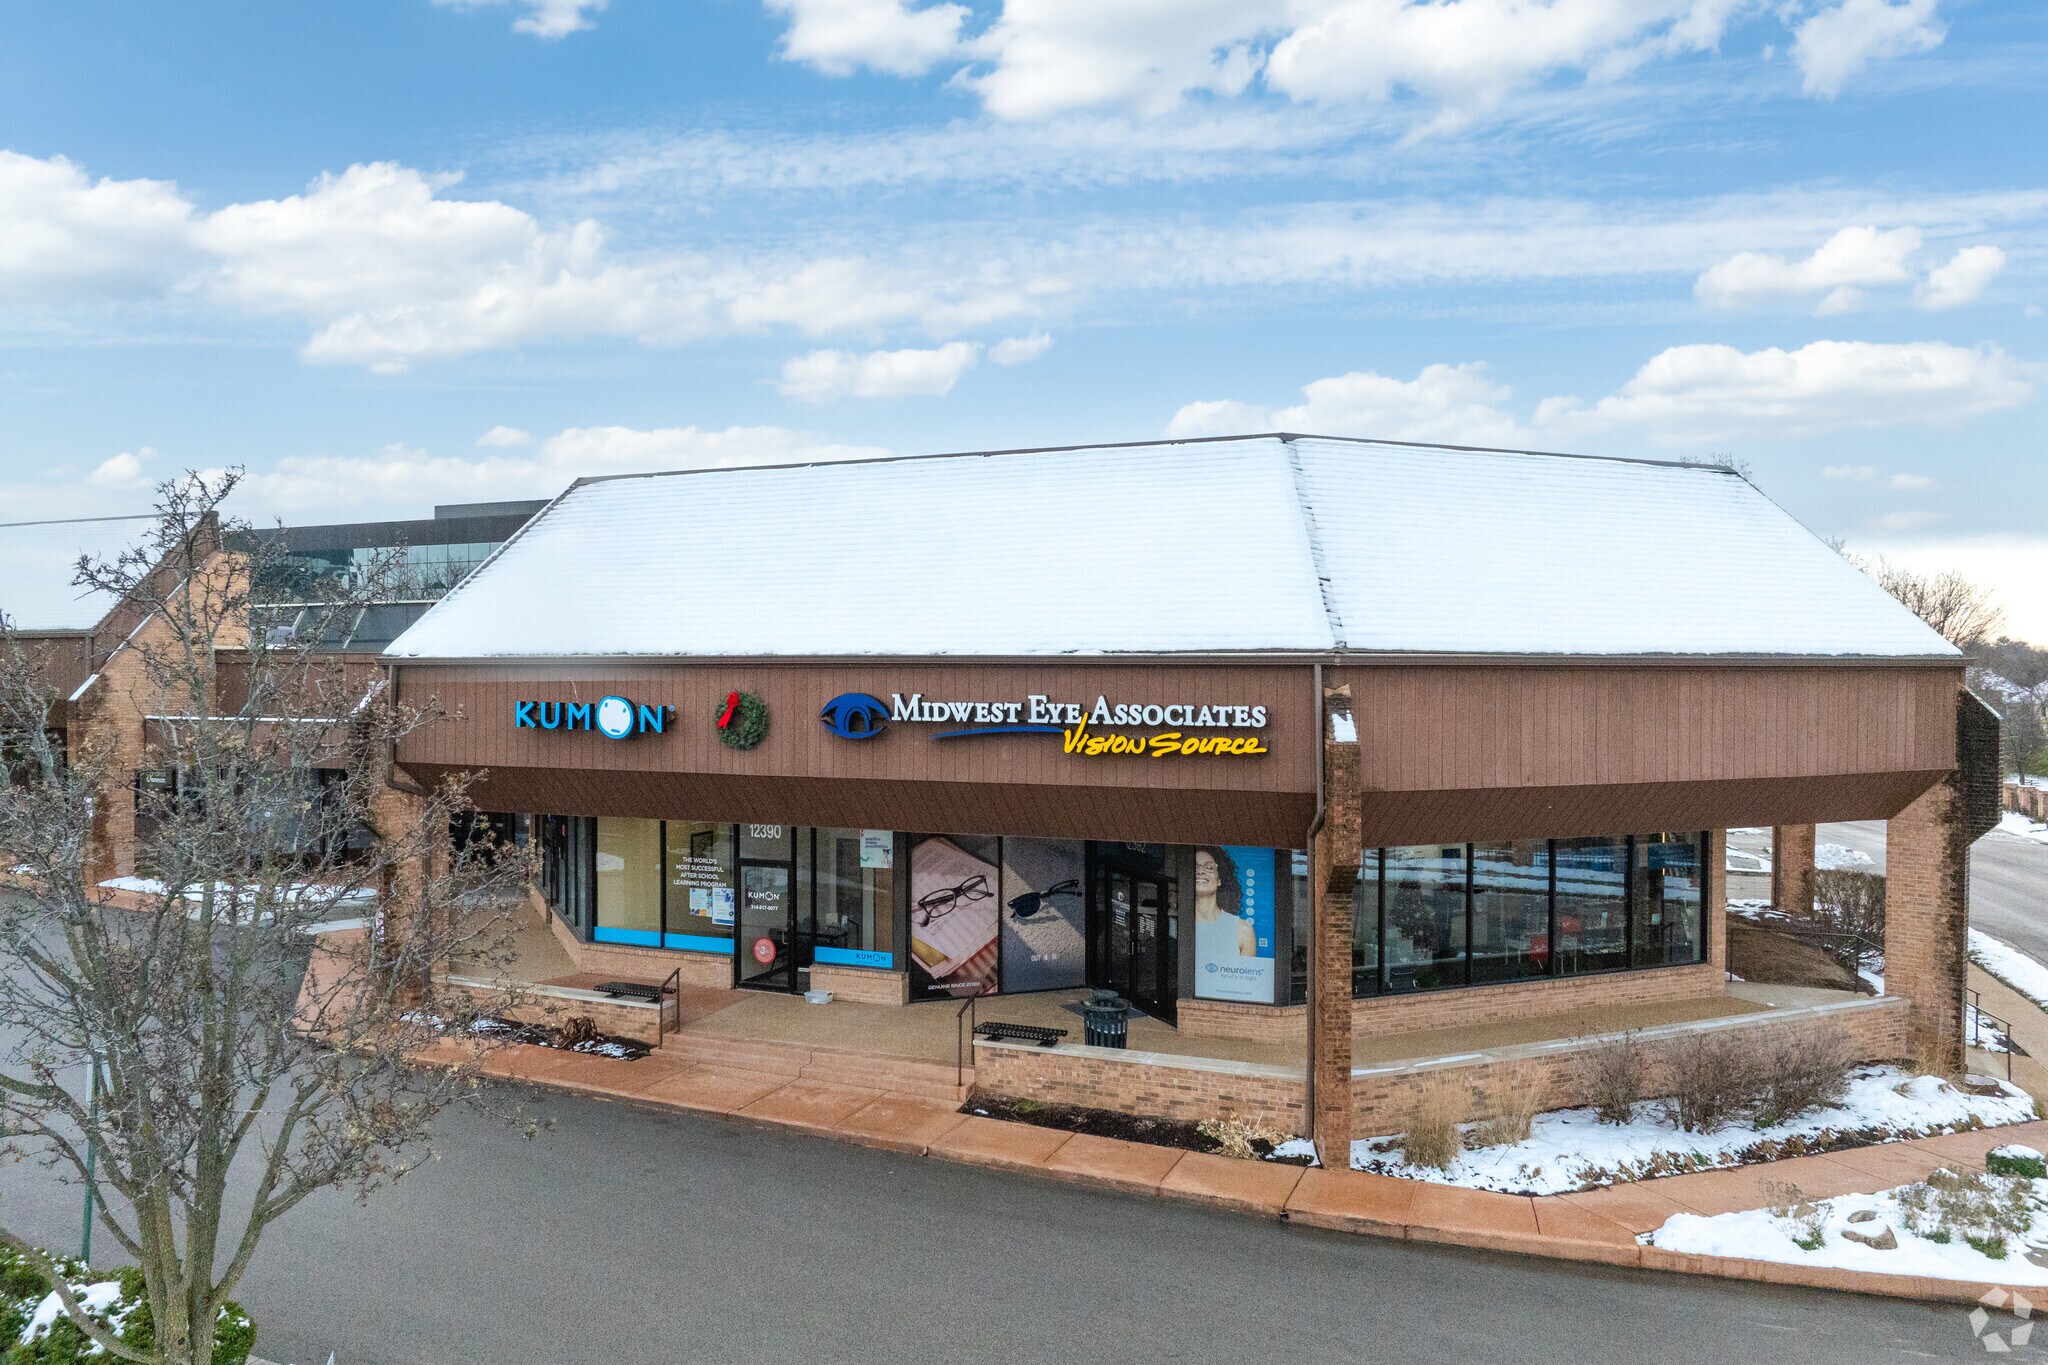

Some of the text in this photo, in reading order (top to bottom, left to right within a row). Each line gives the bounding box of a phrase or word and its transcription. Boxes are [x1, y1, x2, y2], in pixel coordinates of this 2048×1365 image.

[891, 693, 1267, 728] MIDWEST EYE ASSOCIATES
[516, 695, 663, 739] KUMON
[749, 824, 782, 839] 12390
[691, 865, 724, 873] SUCCESSFUL
[698, 872, 720, 880] SCHOOL
[673, 879, 700, 887] LEARNING
[748, 891, 780, 900] KUMON
[856, 952, 886, 963] KUMON
[1220, 966, 1262, 976] neurolens
